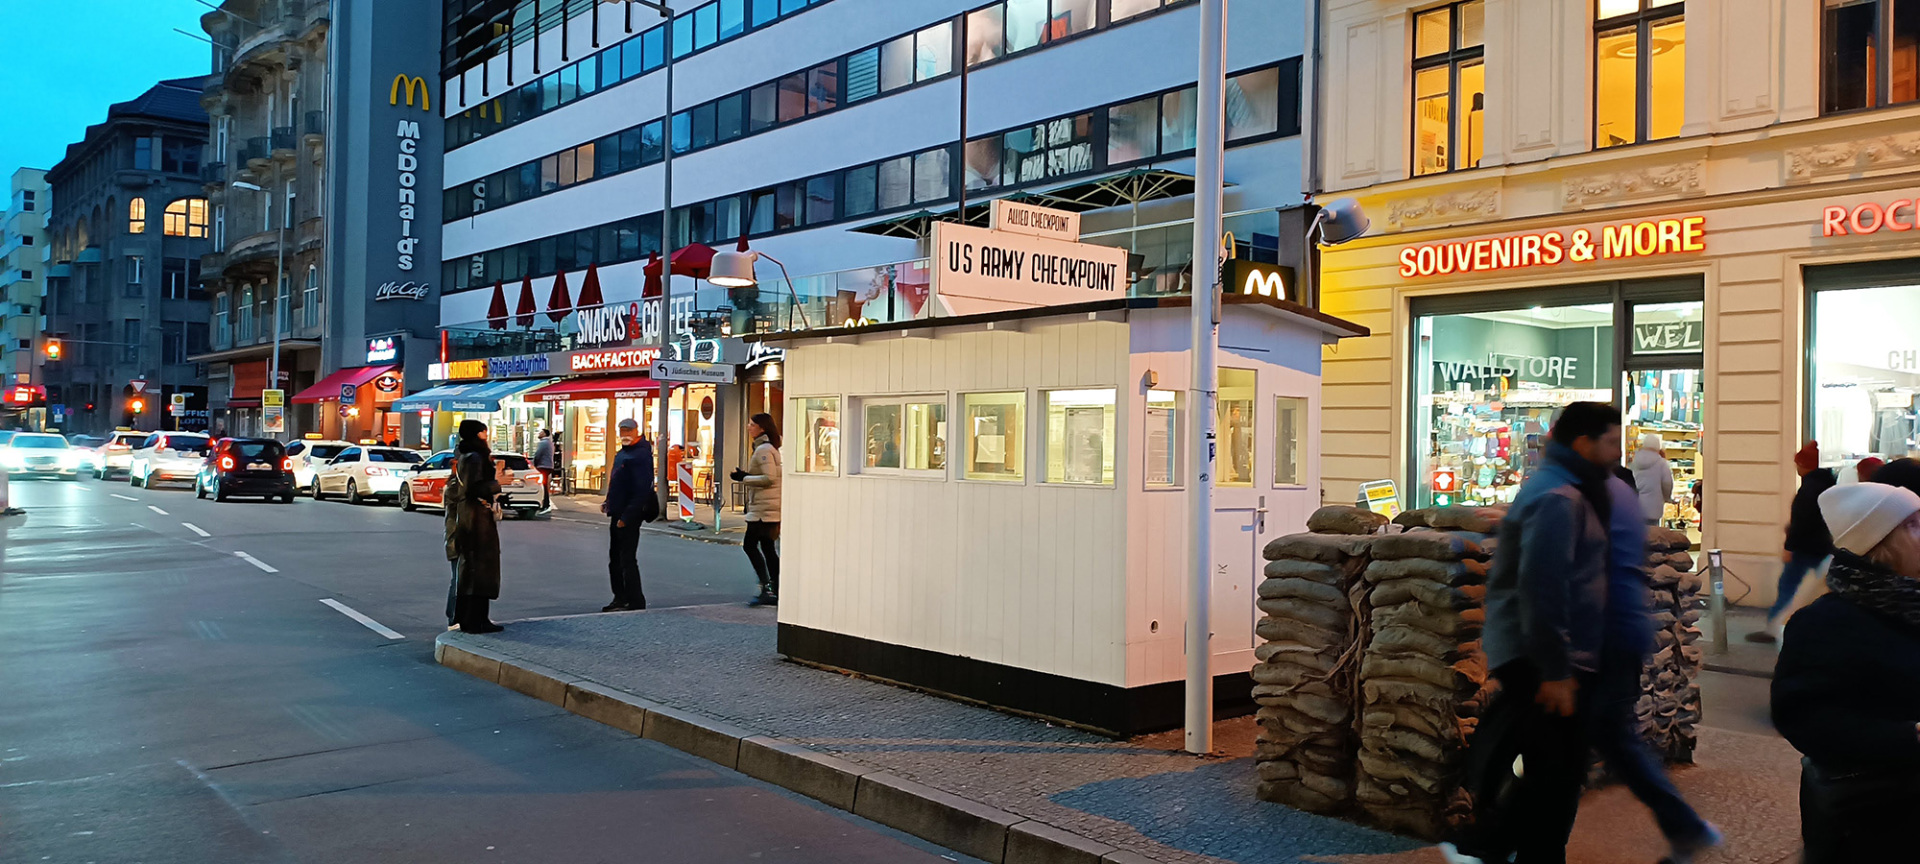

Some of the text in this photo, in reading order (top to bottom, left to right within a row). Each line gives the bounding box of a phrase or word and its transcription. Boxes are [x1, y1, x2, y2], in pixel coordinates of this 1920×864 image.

[397, 120, 420, 271] McDonald's
[1823, 199, 1920, 237] ROC
[1007, 208, 1070, 233] ALLIED CHECKPOINT
[981, 246, 1025, 281] ARMY
[1031, 253, 1118, 292] CHECKPOINT
[1400, 216, 1705, 278] SOUVENIRS & MORE
[577, 296, 693, 344] SNACKS & COFEE
[672, 367, 725, 377] Jüdisches Museum
